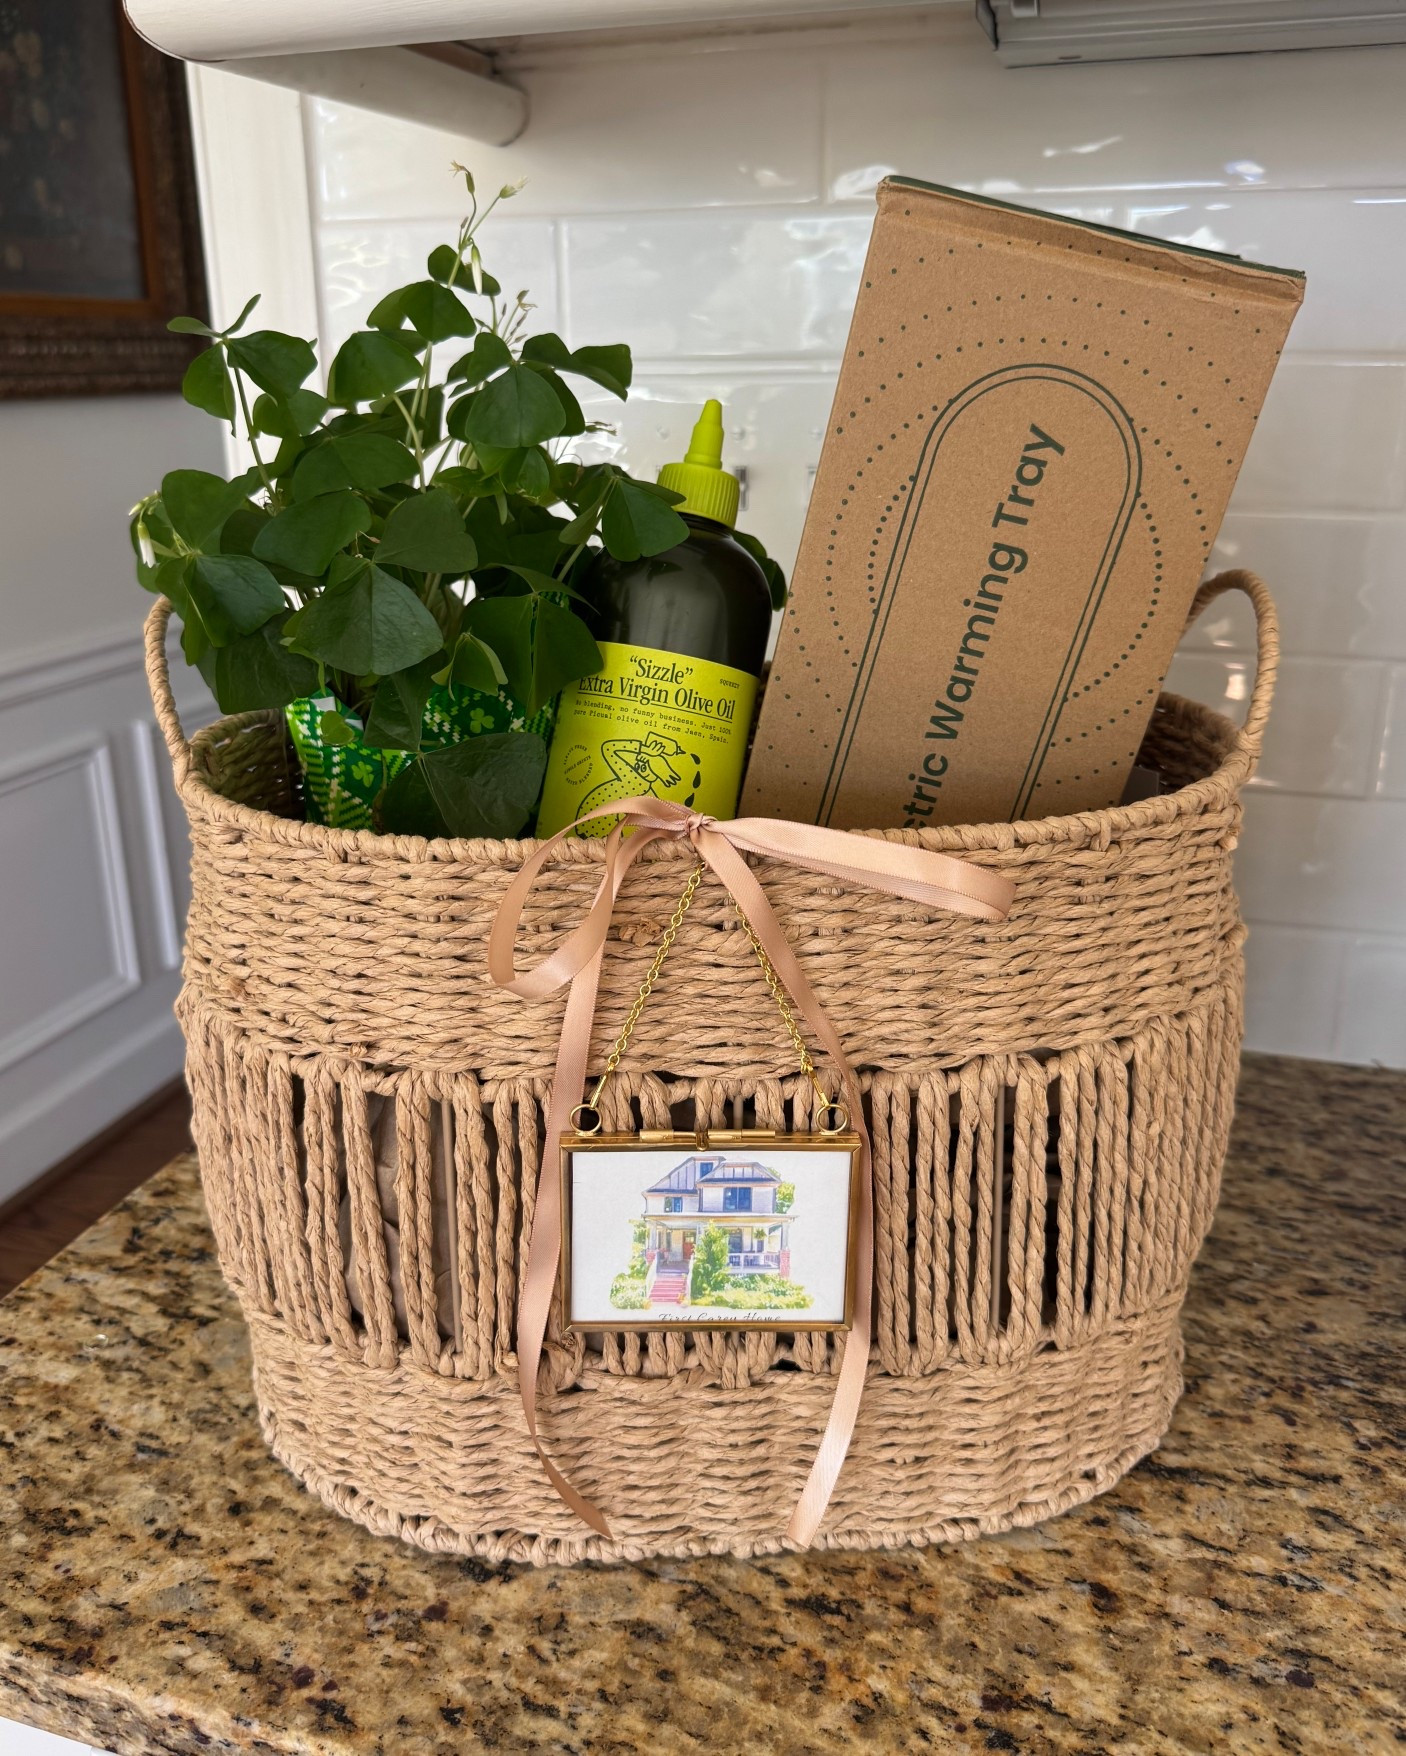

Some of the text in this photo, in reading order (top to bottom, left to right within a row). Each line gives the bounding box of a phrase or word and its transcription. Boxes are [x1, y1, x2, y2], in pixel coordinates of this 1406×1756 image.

[925, 541, 1029, 741] Warming
[991, 423, 1066, 530] Tray
[578, 676, 736, 720] Extra Virgin Olive Oil
[584, 700, 615, 711] blending,
[633, 708, 656, 718] funny
[659, 712, 696, 726] business.
[701, 722, 716, 731] Just
[590, 710, 612, 720] Picual
[616, 715, 640, 724] olive
[644, 720, 658, 728] oil
[662, 723, 682, 732] from
